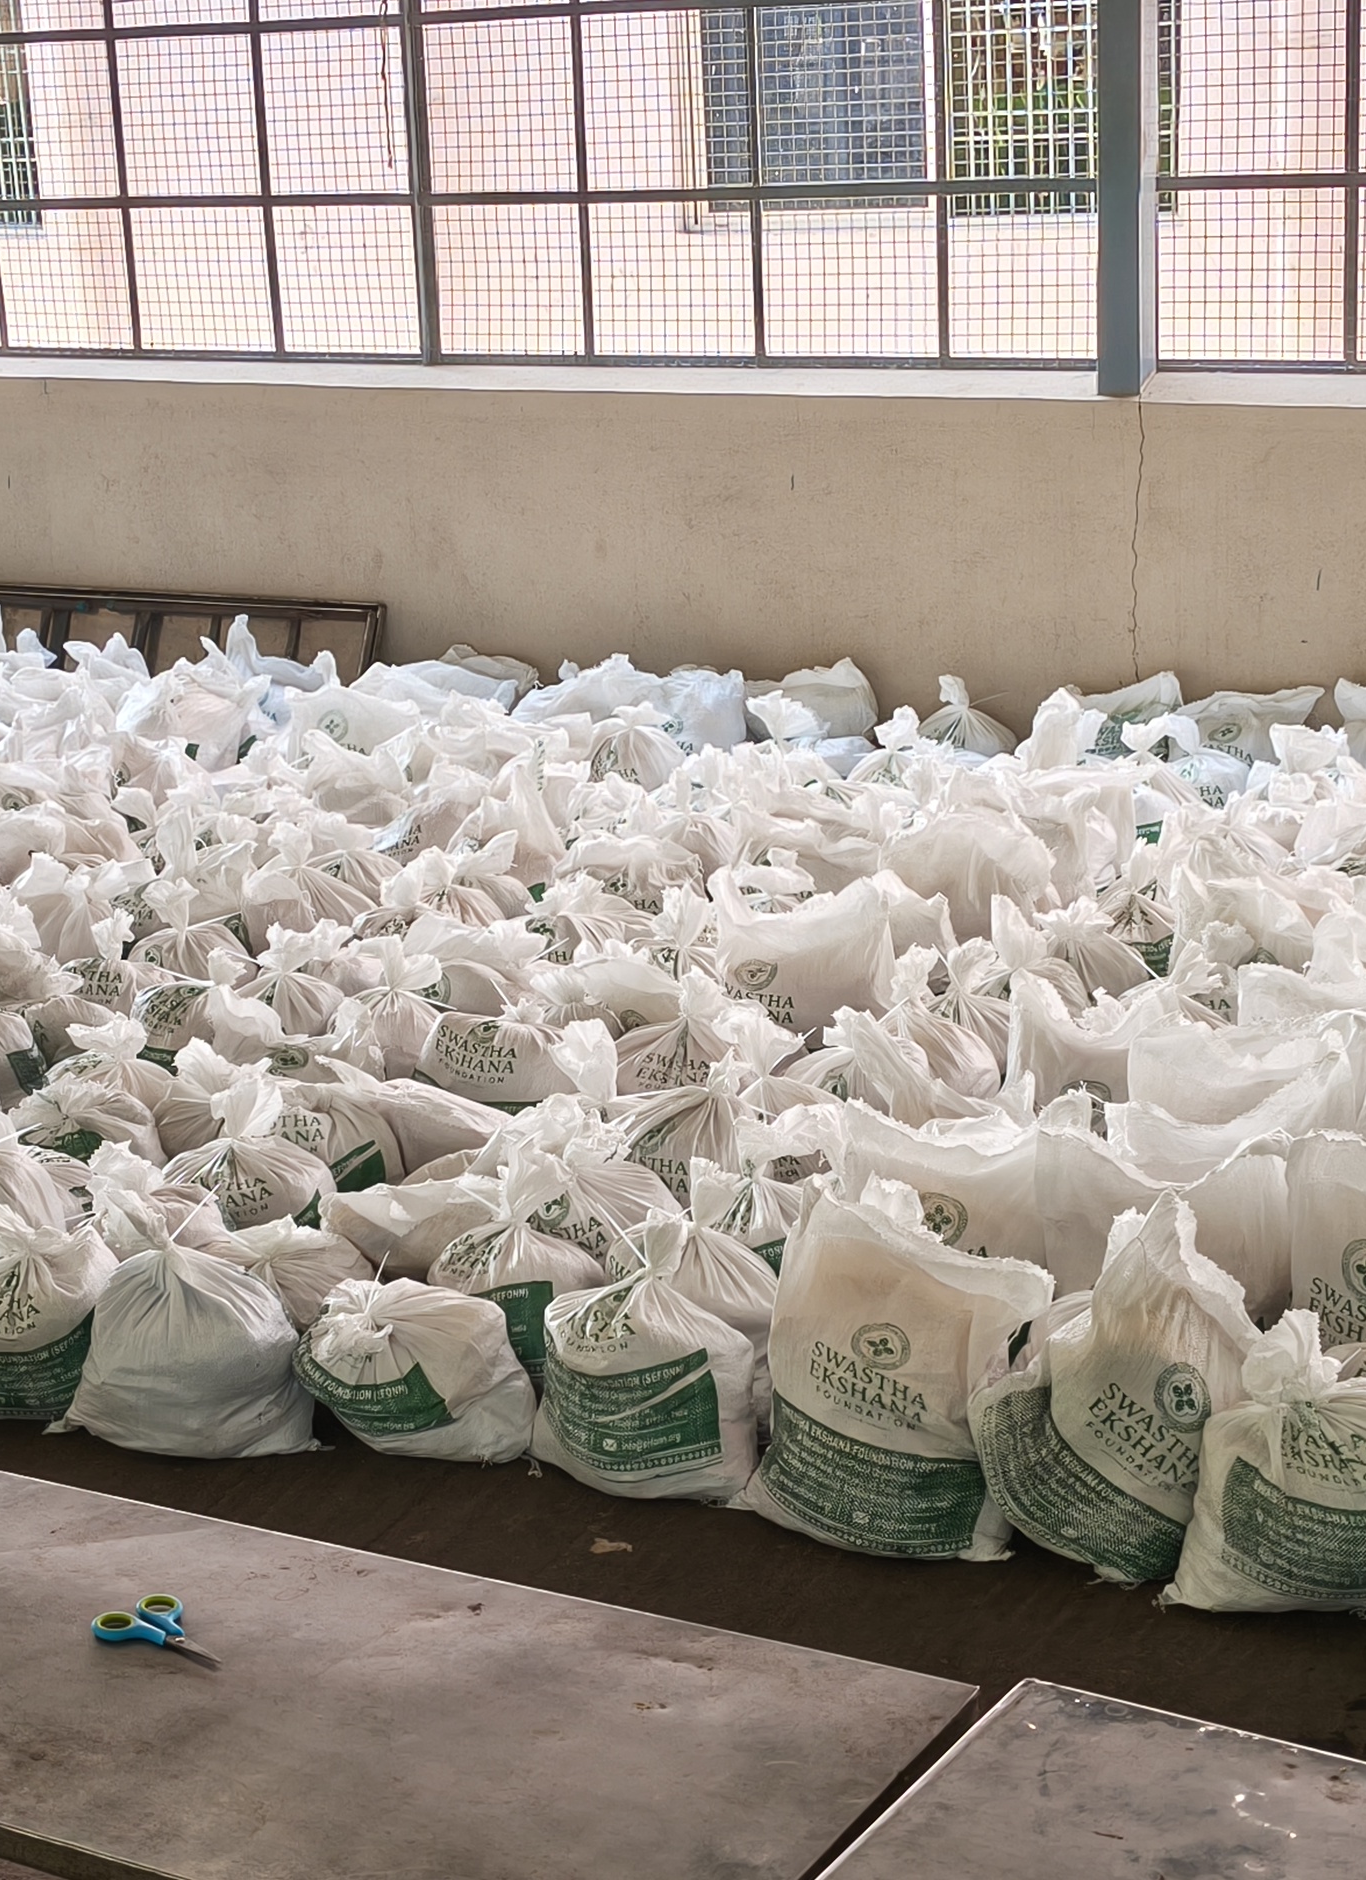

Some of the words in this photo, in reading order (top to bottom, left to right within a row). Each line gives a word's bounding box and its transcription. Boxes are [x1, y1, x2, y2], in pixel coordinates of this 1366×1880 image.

[436, 1038, 514, 1074] EKSHANA
[438, 1024, 518, 1059] SWASTHA
[438, 1057, 505, 1084] FOUNDATION
[809, 1358, 923, 1424] EKSHANA
[811, 1340, 928, 1413] SWASTHA
[815, 1384, 917, 1432] FOUNDATION
[1103, 1382, 1200, 1475] SWASTH
